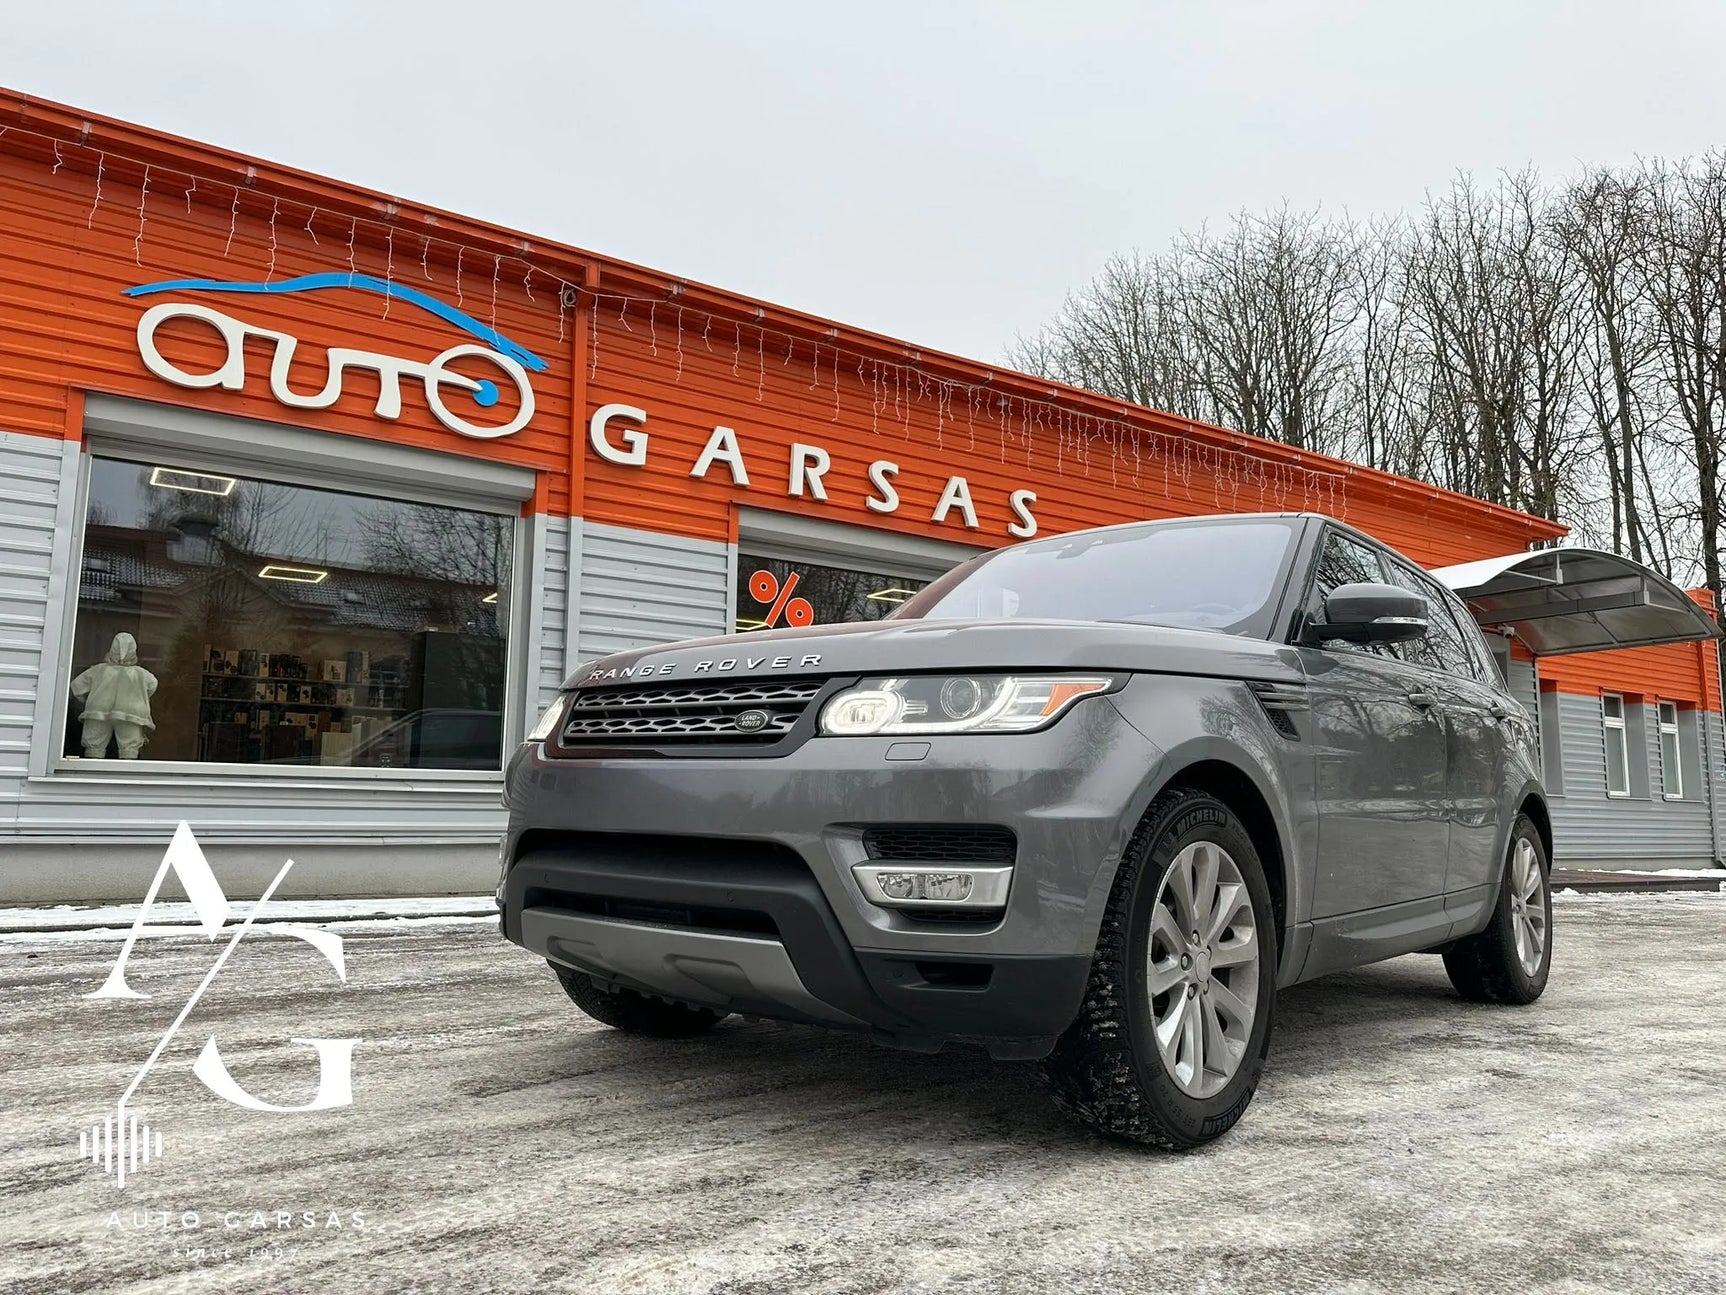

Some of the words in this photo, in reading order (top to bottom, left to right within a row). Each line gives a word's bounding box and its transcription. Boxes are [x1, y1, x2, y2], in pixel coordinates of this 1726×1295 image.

[588, 402, 1040, 539] GARSAS
[589, 663, 677, 681] RANGE
[694, 653, 823, 673] ROVER
[1176, 807, 1228, 837] MICHELIN
